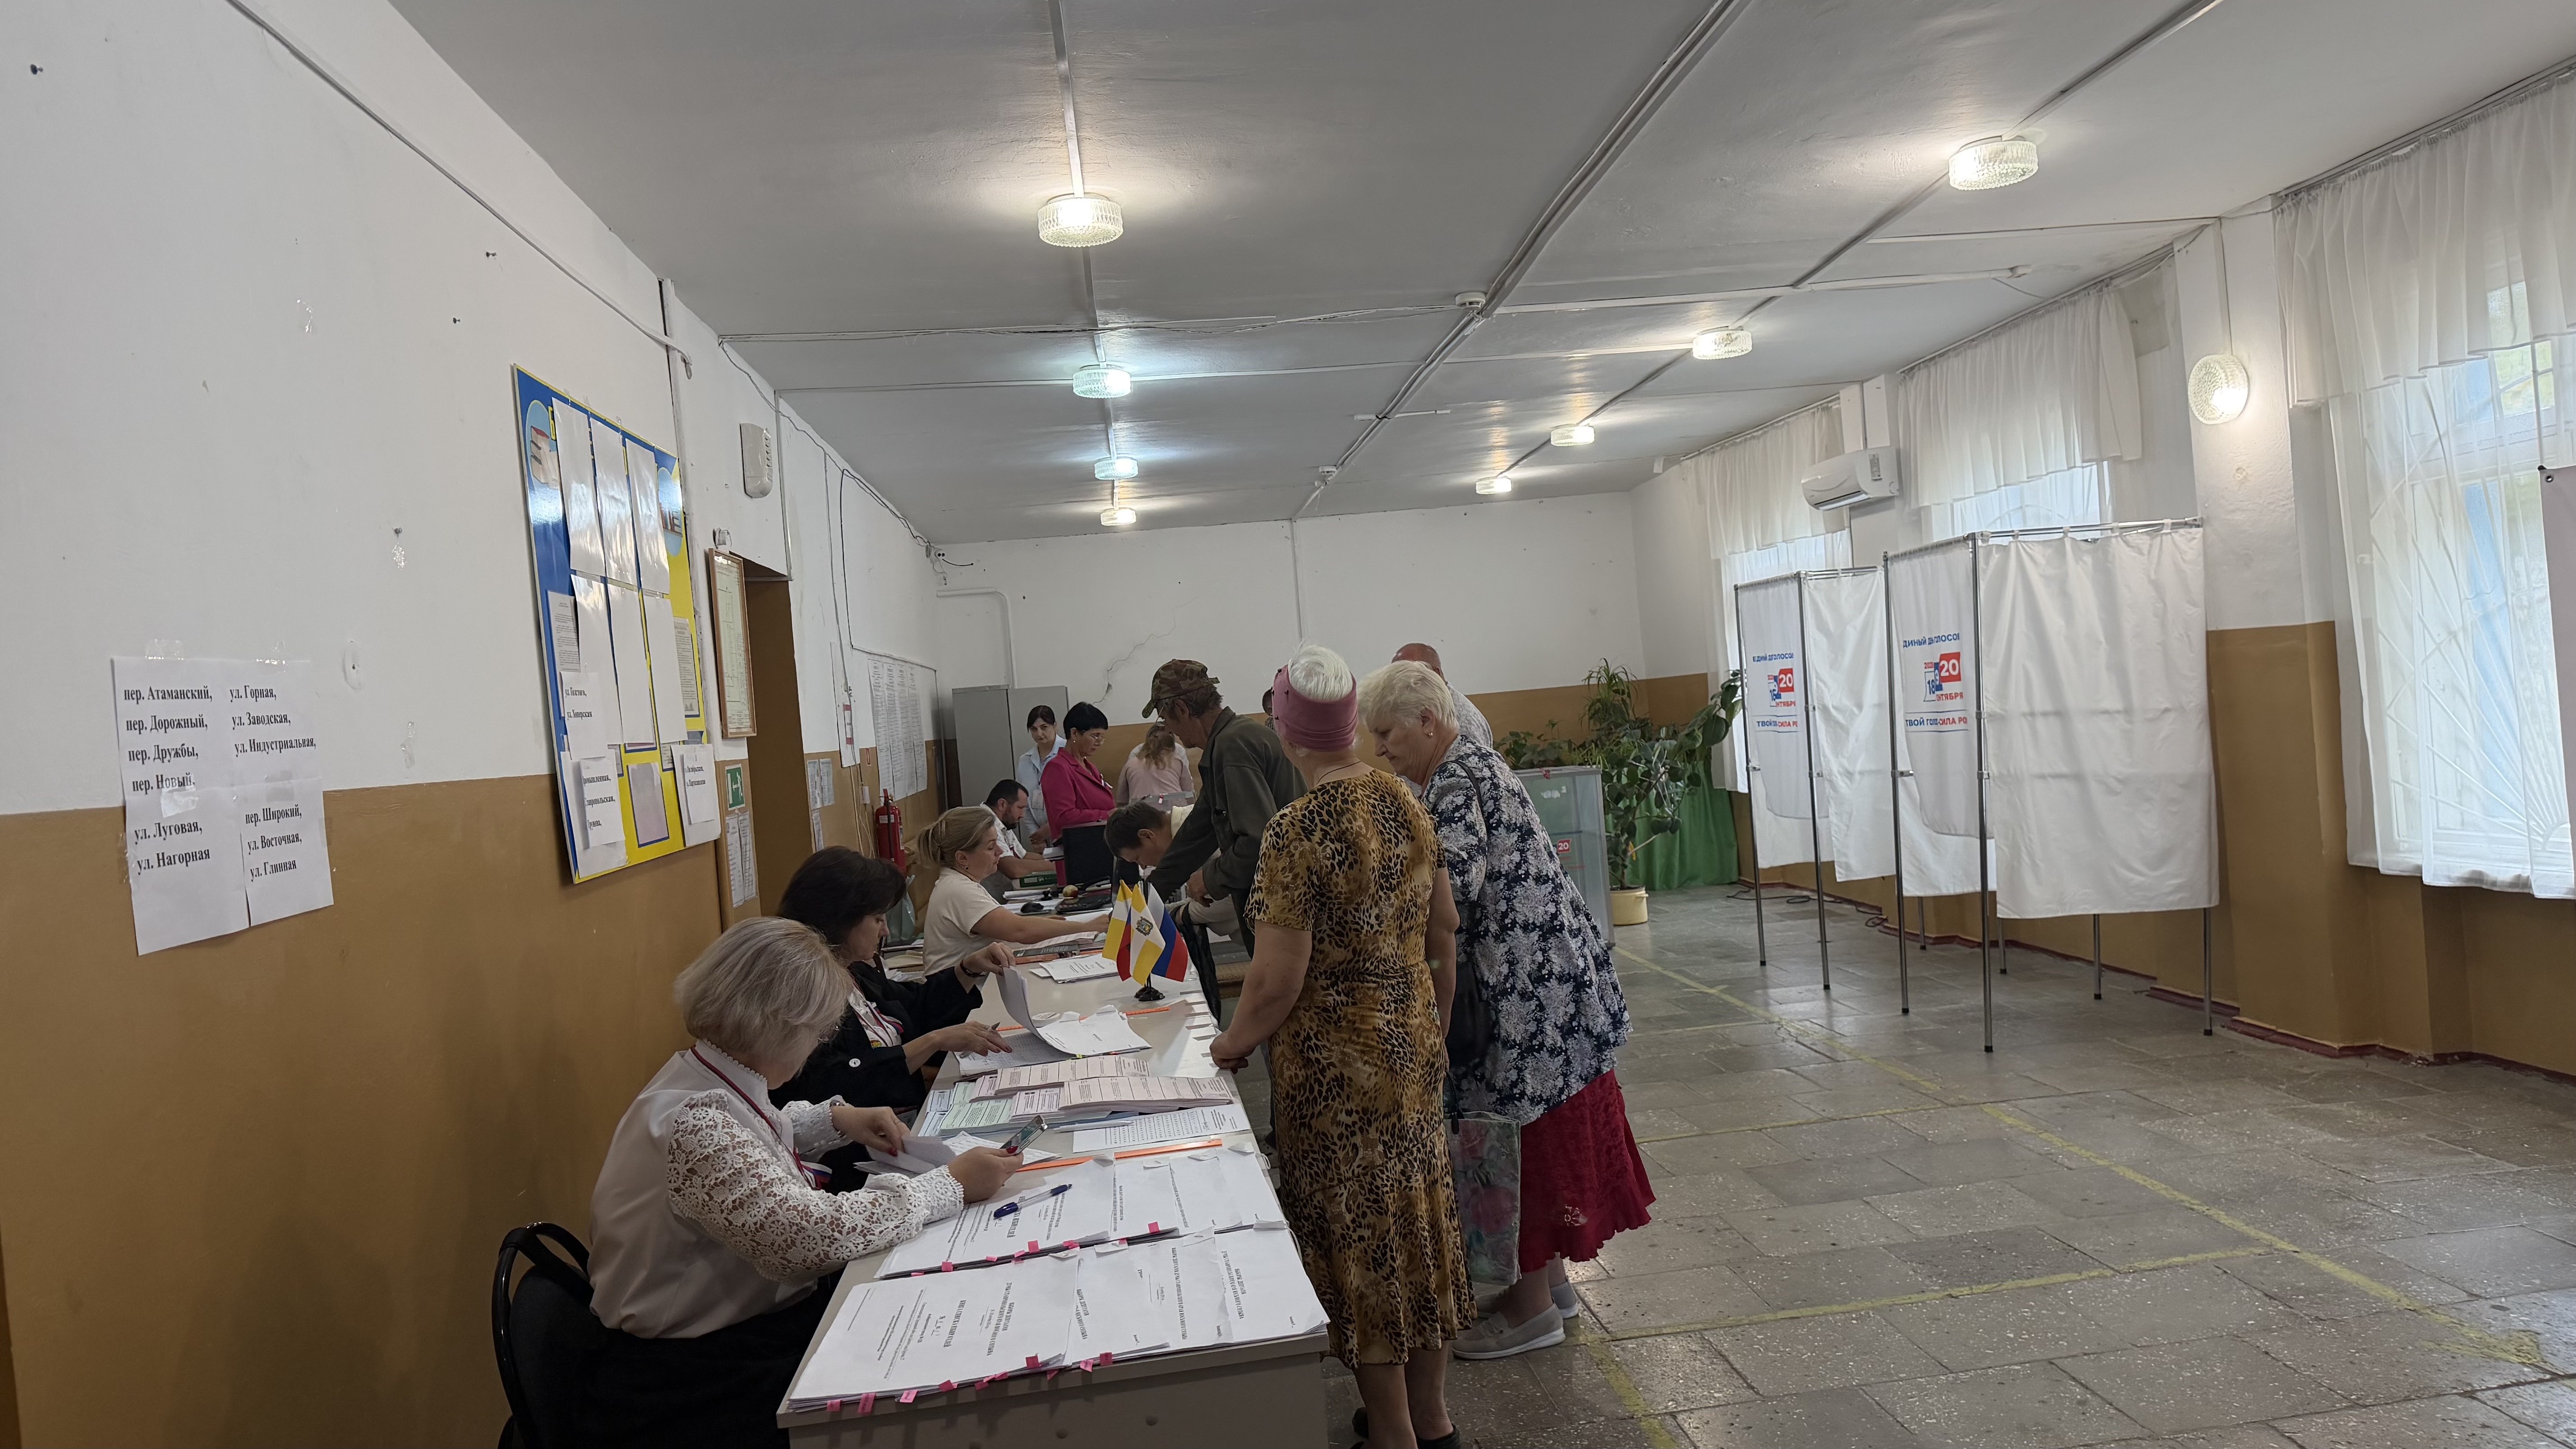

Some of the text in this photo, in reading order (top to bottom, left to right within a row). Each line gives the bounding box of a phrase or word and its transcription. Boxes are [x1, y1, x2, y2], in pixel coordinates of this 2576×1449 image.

[1940, 659, 1959, 676] 20
[1779, 673, 1793, 687] 20
[124, 685, 212, 704] пер. Атаманский,
[230, 685, 276, 703] ул. Горная,
[126, 714, 208, 734] пер. Дорожный,
[232, 712, 291, 730] ул. Заводская,
[1905, 717, 1925, 727] ТВОЙ
[129, 743, 198, 764] пер. Дружбы,
[235, 738, 316, 757] ул. Индустриальная,
[132, 772, 195, 795] пер. Новый,
[245, 804, 302, 827] пер. Широкий,
[134, 822, 202, 845] ул. Луговая,
[248, 833, 302, 855] ул. Восточная,
[1558, 842, 1569, 851] 20
[137, 849, 210, 875] ул. Нагорная
[250, 860, 297, 882] ул. Глинная
